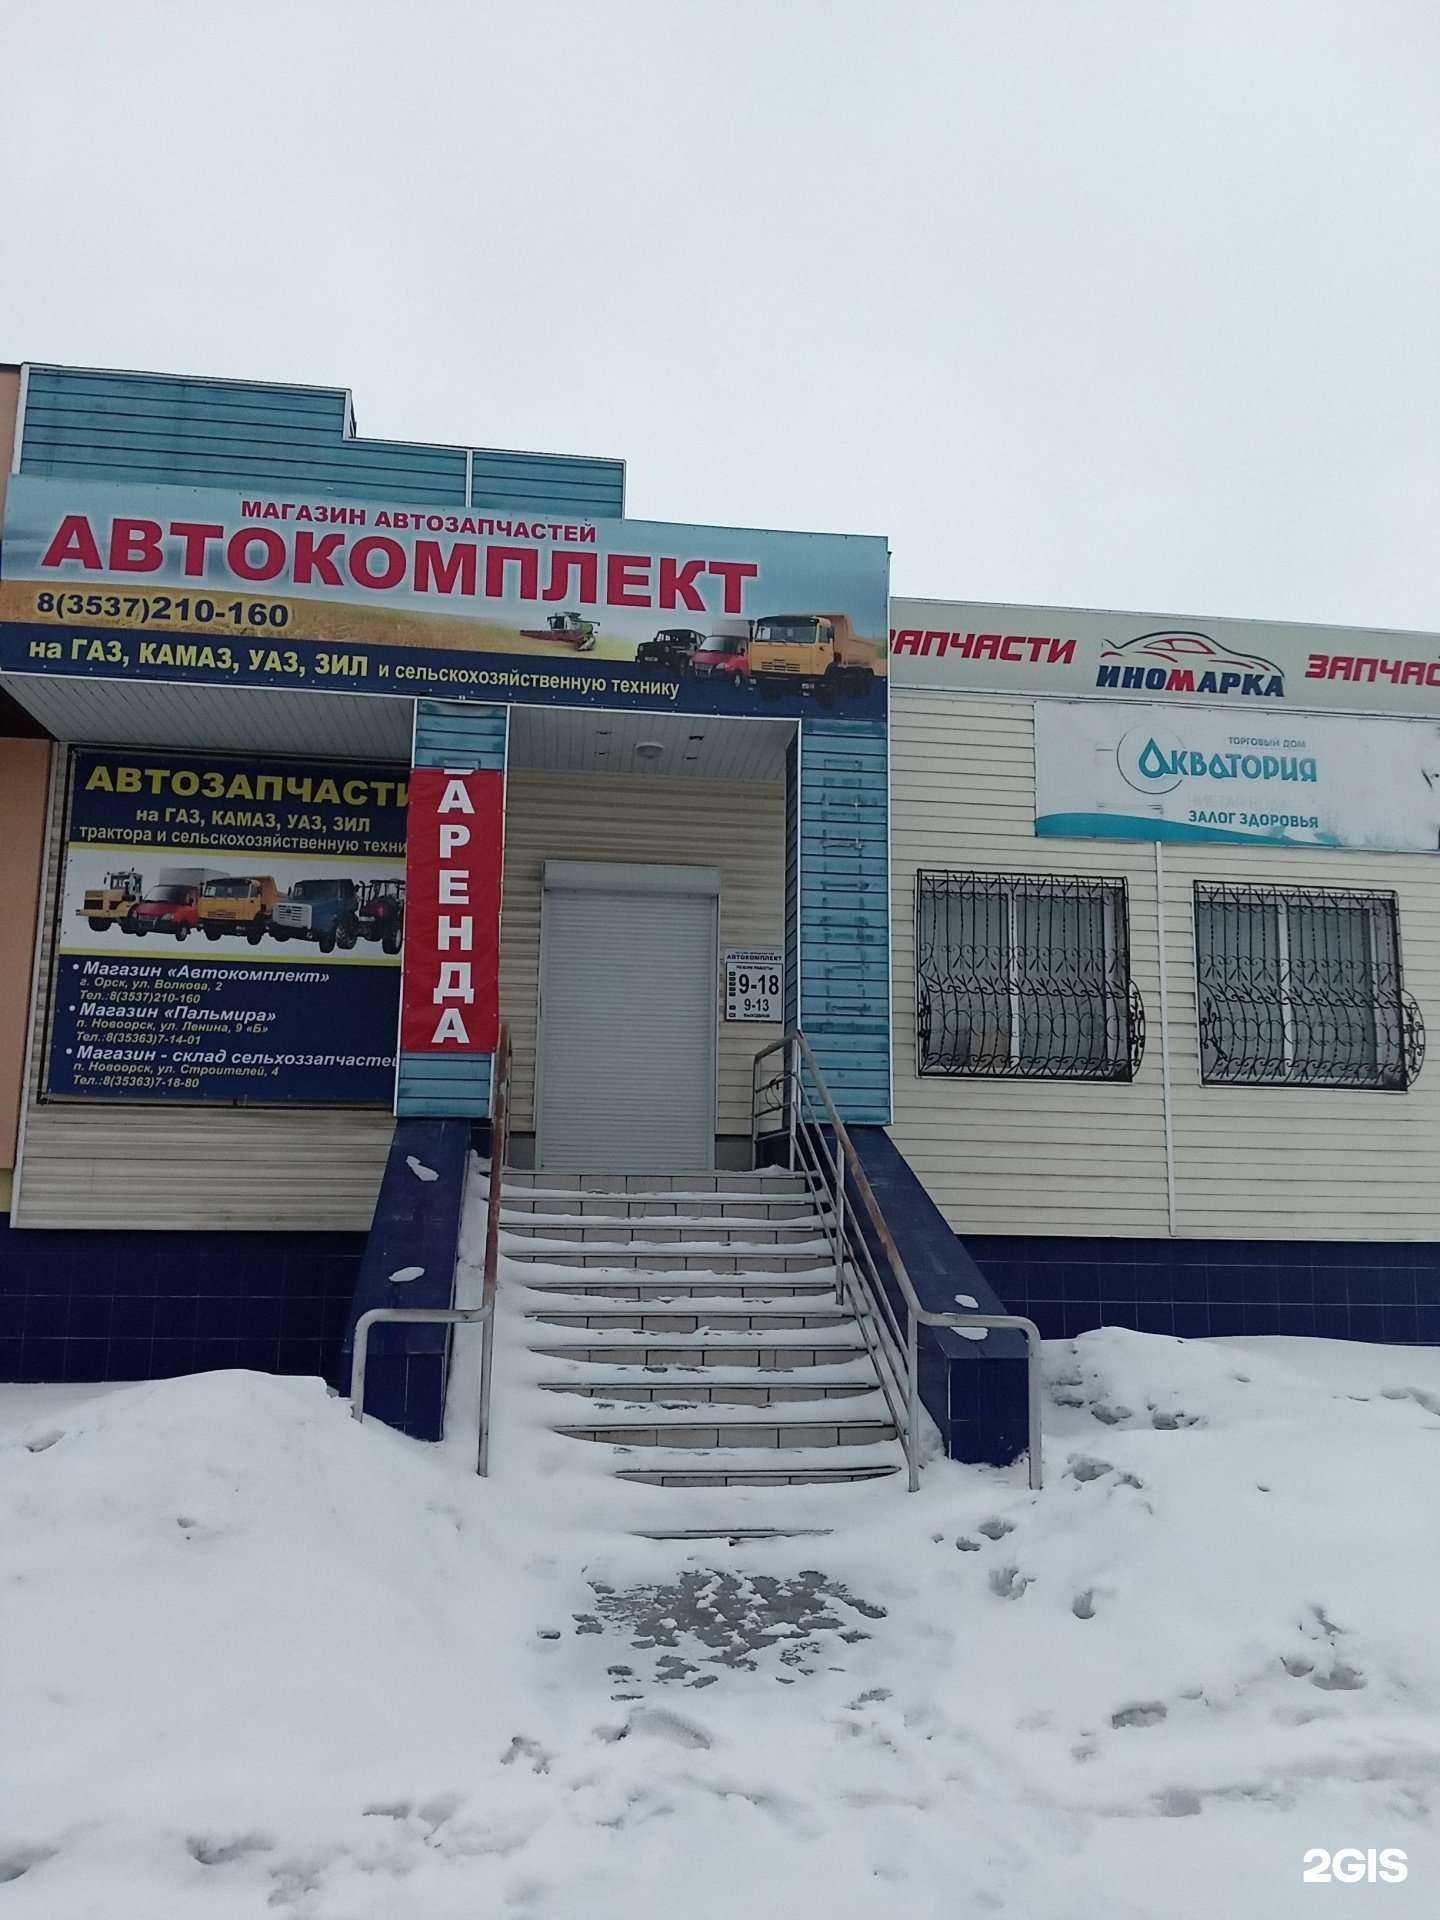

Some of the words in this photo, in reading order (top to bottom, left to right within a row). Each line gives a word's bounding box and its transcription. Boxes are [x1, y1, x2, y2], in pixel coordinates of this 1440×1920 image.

[241, 500, 366, 527] МАГАЗИН
[375, 511, 596, 543] АВТОЗАПЧАСТЕЙ
[41, 515, 758, 614] АВТОКОМПЛЕКТ
[37, 592, 289, 628] 8(3537)210-160
[29, 640, 61, 660] на
[71, 639, 129, 668] ГАЗ,
[139, 643, 240, 673] КАМАЗ,
[248, 649, 305, 677] УАЗ,
[314, 653, 369, 677] ЗИЛ
[378, 664, 390, 679] и
[395, 664, 607, 693] сельскохозяйственную
[612, 679, 680, 700] технику
[1096, 665, 1284, 697] ИНОМАРКА
[1283, 739, 1307, 748] ДОМ
[1138, 737, 1317, 782] АКВАТОРИЯ
[135, 809, 159, 822] на
[164, 807, 205, 827] ГАЗ,
[211, 810, 281, 831] КАМАЗ,
[287, 814, 327, 833] УАЗ,
[333, 816, 371, 833] ЗИЛ
[1189, 810, 1236, 825] ЗАЛОГ
[1239, 813, 1319, 829] ЗДОРОВЬЯ
[80, 826, 152, 844] трактора
[157, 831, 166, 842] и
[171, 831, 358, 854] сельскохозяйственную
[431, 779, 475, 1045] АРЕНДА
[83, 961, 162, 977] Магазин
[168, 964, 330, 983] «Автокомплект»
[94, 976, 128, 989] Орск,
[132, 979, 150, 990] ул.
[154, 978, 211, 992] Волкова,
[215, 981, 224, 991] 2
[738, 973, 779, 995] 9-18
[80, 1003, 159, 1018] Магазин
[164, 1005, 276, 1024] «Пальмира»
[743, 998, 769, 1012] 9-13
[76, 1019, 87, 1028] п.
[91, 1018, 155, 1031] Новоорск,
[160, 1021, 178, 1032] ул.
[182, 1022, 231, 1034] Ленина,
[235, 1023, 243, 1033] 9
[76, 1045, 156, 1061] Магазин
[172, 1049, 227, 1063] склад
[73, 1063, 84, 1071] п.
[88, 1062, 154, 1075] Новоорск,
[157, 1064, 175, 1075] ул.
[180, 1064, 268, 1077] Строителей,
[271, 1066, 280, 1076] 4
